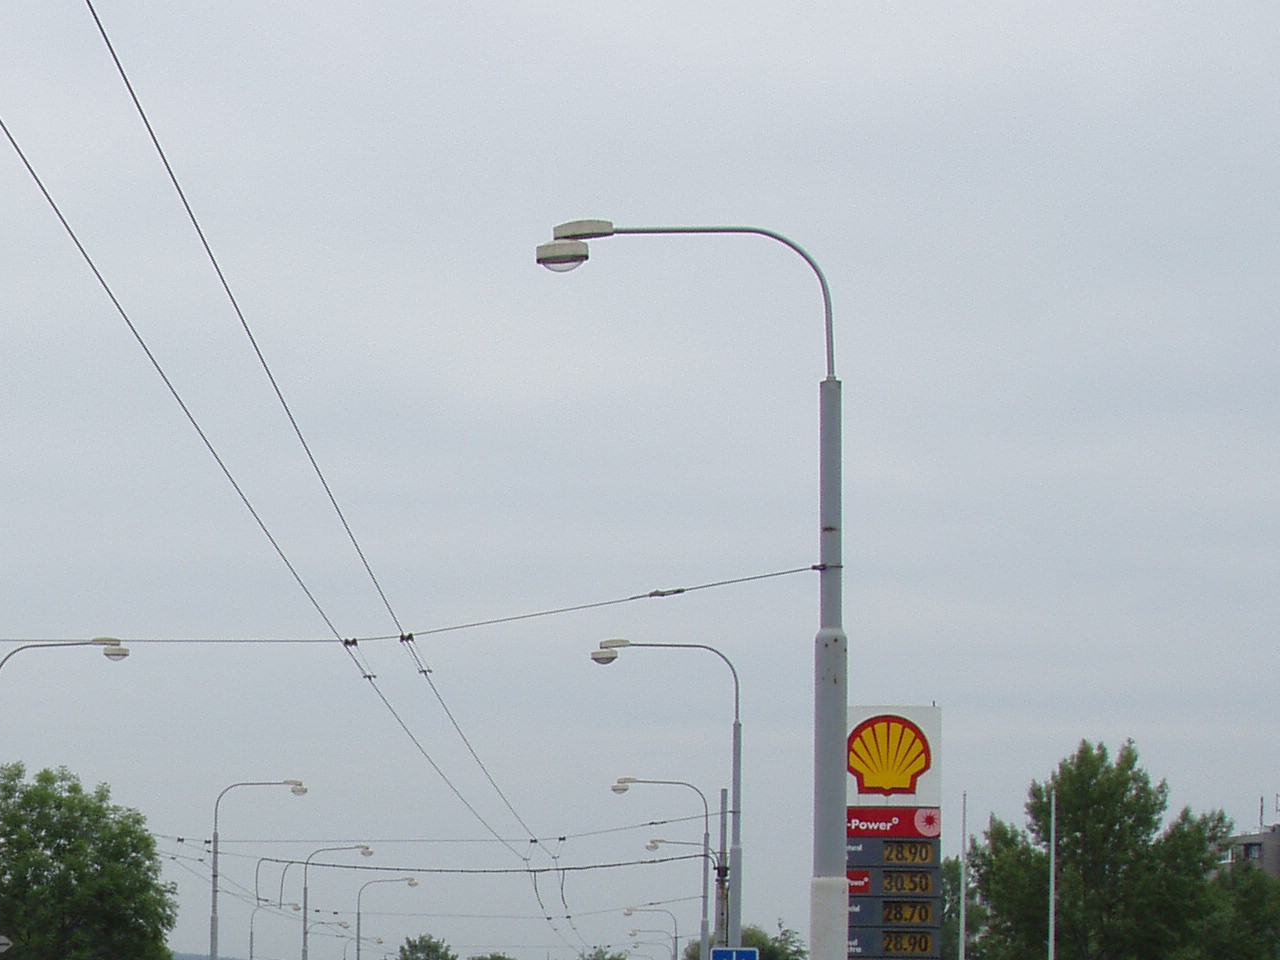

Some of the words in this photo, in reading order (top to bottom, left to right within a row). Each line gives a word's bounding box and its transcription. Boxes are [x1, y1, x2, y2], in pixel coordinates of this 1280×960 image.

[847, 819, 893, 831] -Power
[883, 842, 929, 862] 28.90
[883, 872, 929, 892] 30.50
[883, 903, 929, 922] 28.70
[883, 934, 929, 952] 28.90
